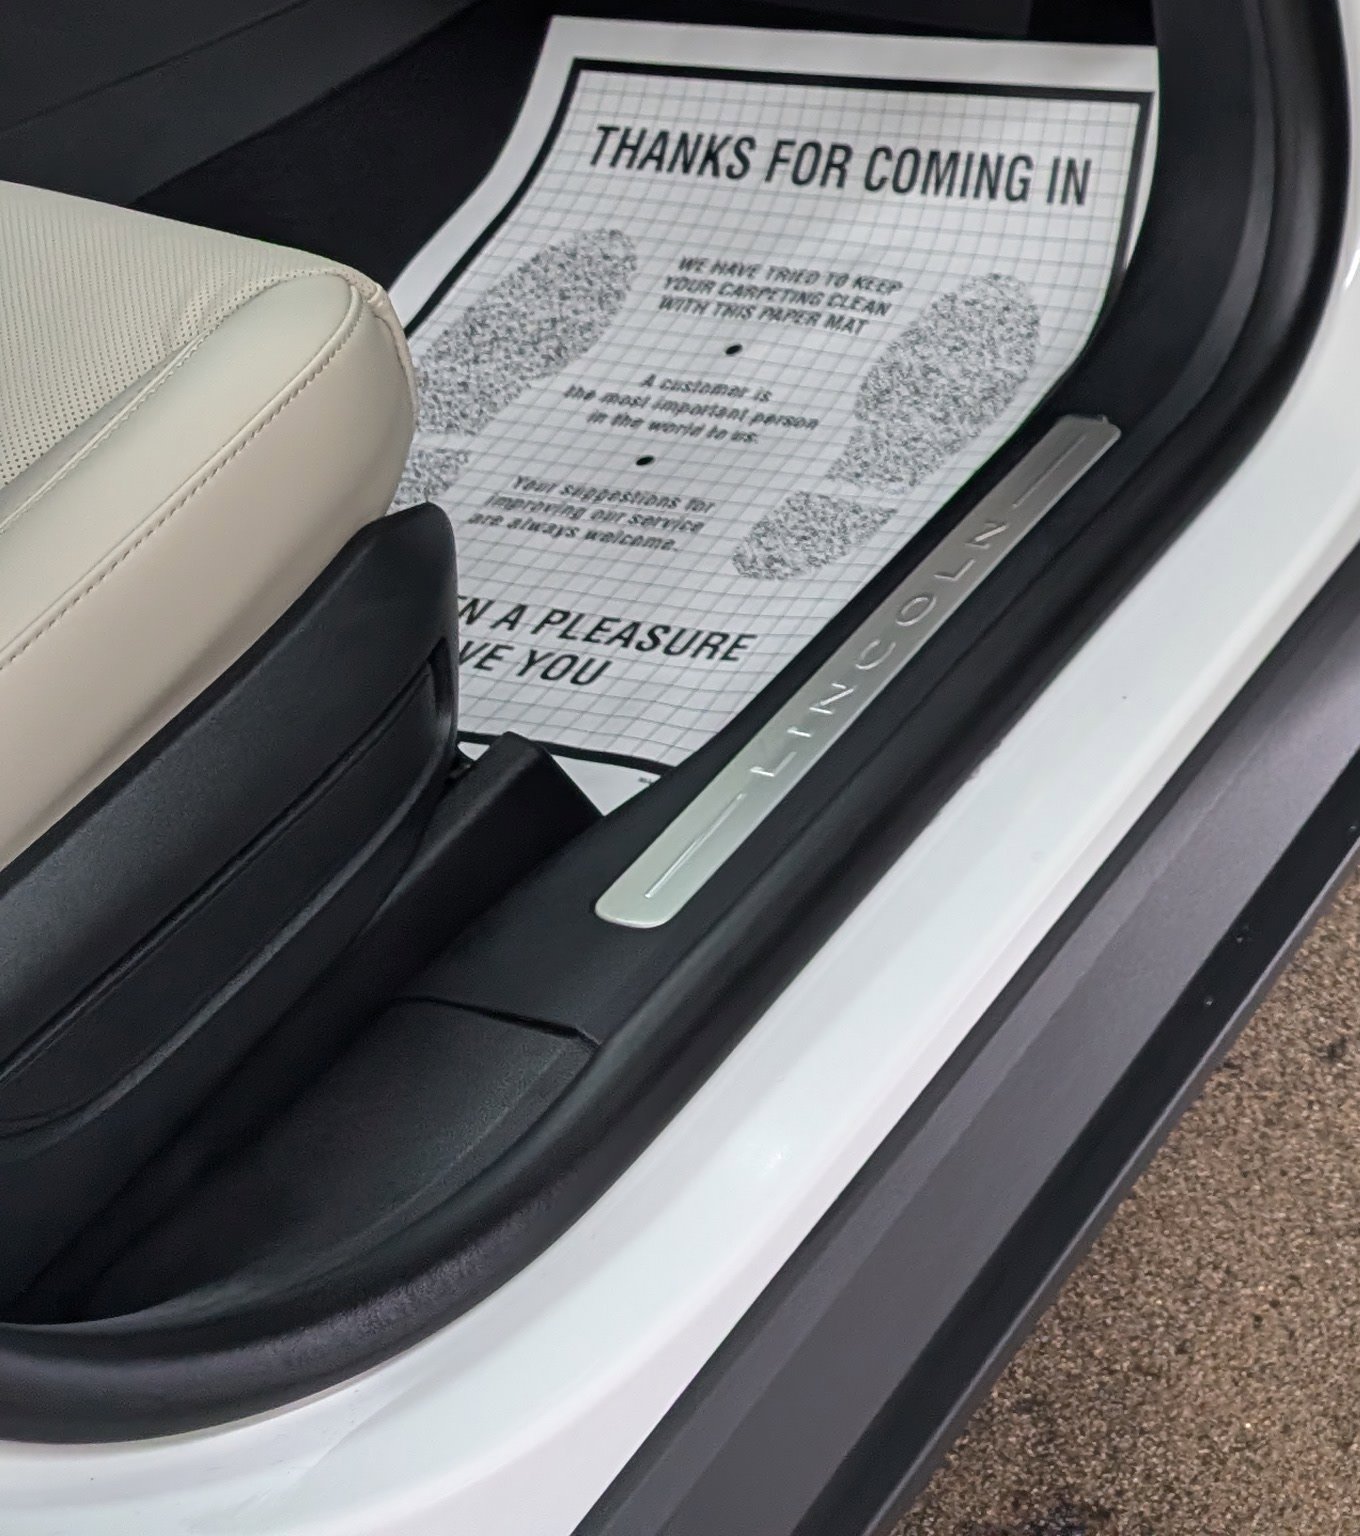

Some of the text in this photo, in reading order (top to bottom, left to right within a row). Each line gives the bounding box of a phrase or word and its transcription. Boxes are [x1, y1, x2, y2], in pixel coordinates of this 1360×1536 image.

[590, 125, 1092, 206] THANKS FOR COMING IN
[679, 256, 902, 295] WE HAVE TRIED TO KEEP
[659, 295, 869, 335] WITH THIS PAPER MAT
[664, 276, 891, 316] YOUR CARPETING CLEAN
[564, 384, 819, 430] the most important person
[641, 374, 772, 402] A customer is
[587, 409, 608, 423] in
[611, 412, 644, 428] the
[648, 421, 706, 437] world
[707, 425, 728, 439] to
[513, 475, 715, 513] Your suggestions for
[468, 513, 679, 552] are always welcome.
[486, 495, 705, 533] improving our service
[457, 595, 757, 661] N A PLEASURE
[516, 649, 611, 685] YOU
[750, 520, 1008, 778] LINCOLN
